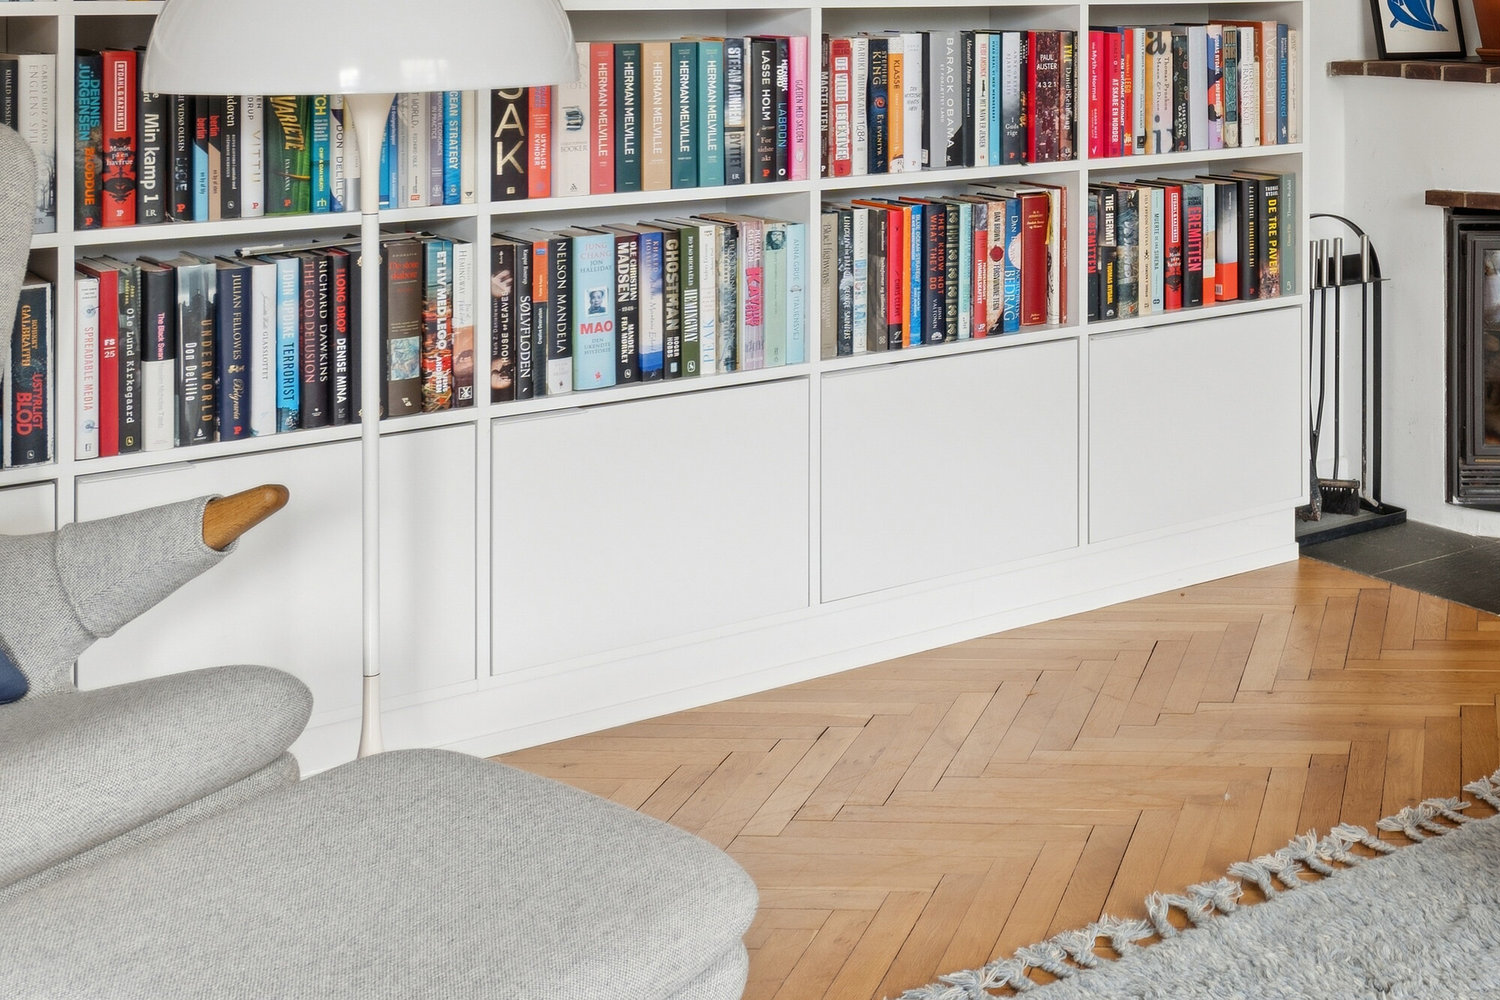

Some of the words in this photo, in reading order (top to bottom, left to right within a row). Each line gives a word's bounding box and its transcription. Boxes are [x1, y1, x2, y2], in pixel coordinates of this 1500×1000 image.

[598, 62, 608, 106] HERMAN
[762, 50, 770, 86] LASSE
[946, 38, 954, 93] BARACK
[144, 114, 160, 142] Min
[762, 89, 770, 121] HOLM
[946, 98, 954, 148] OBAMA
[598, 108, 608, 157] MELVILLE
[856, 121, 865, 142] 1Q84
[84, 147, 94, 206] BLODDUE
[140, 146, 160, 190] kamp
[144, 194, 158, 204] 1
[1269, 199, 1278, 213] DE
[1269, 218, 1278, 236] TRE
[304, 260, 316, 286] THE
[556, 242, 566, 290] NELSON
[618, 242, 630, 302] MADSEN
[1268, 240, 1278, 276] PAVER
[304, 288, 316, 318] GOD
[318, 260, 328, 319] RICHARD
[666, 238, 679, 331] GHOSTMAN
[1004, 270, 1016, 322] BEDRAG
[124, 308, 135, 328] Ole
[519, 295, 531, 378] SØLVFLODEN
[556, 294, 566, 354] MANDELA
[580, 320, 613, 334] MAO
[124, 331, 135, 356] Lund
[304, 320, 316, 384] DELUSION
[318, 323, 328, 382] DAWKINS
[123, 360, 135, 424] Kirkegaard
[200, 318, 213, 422] UNDERWORLD
[282, 342, 294, 402] TERRORIST
[16, 392, 32, 436] BLOD
